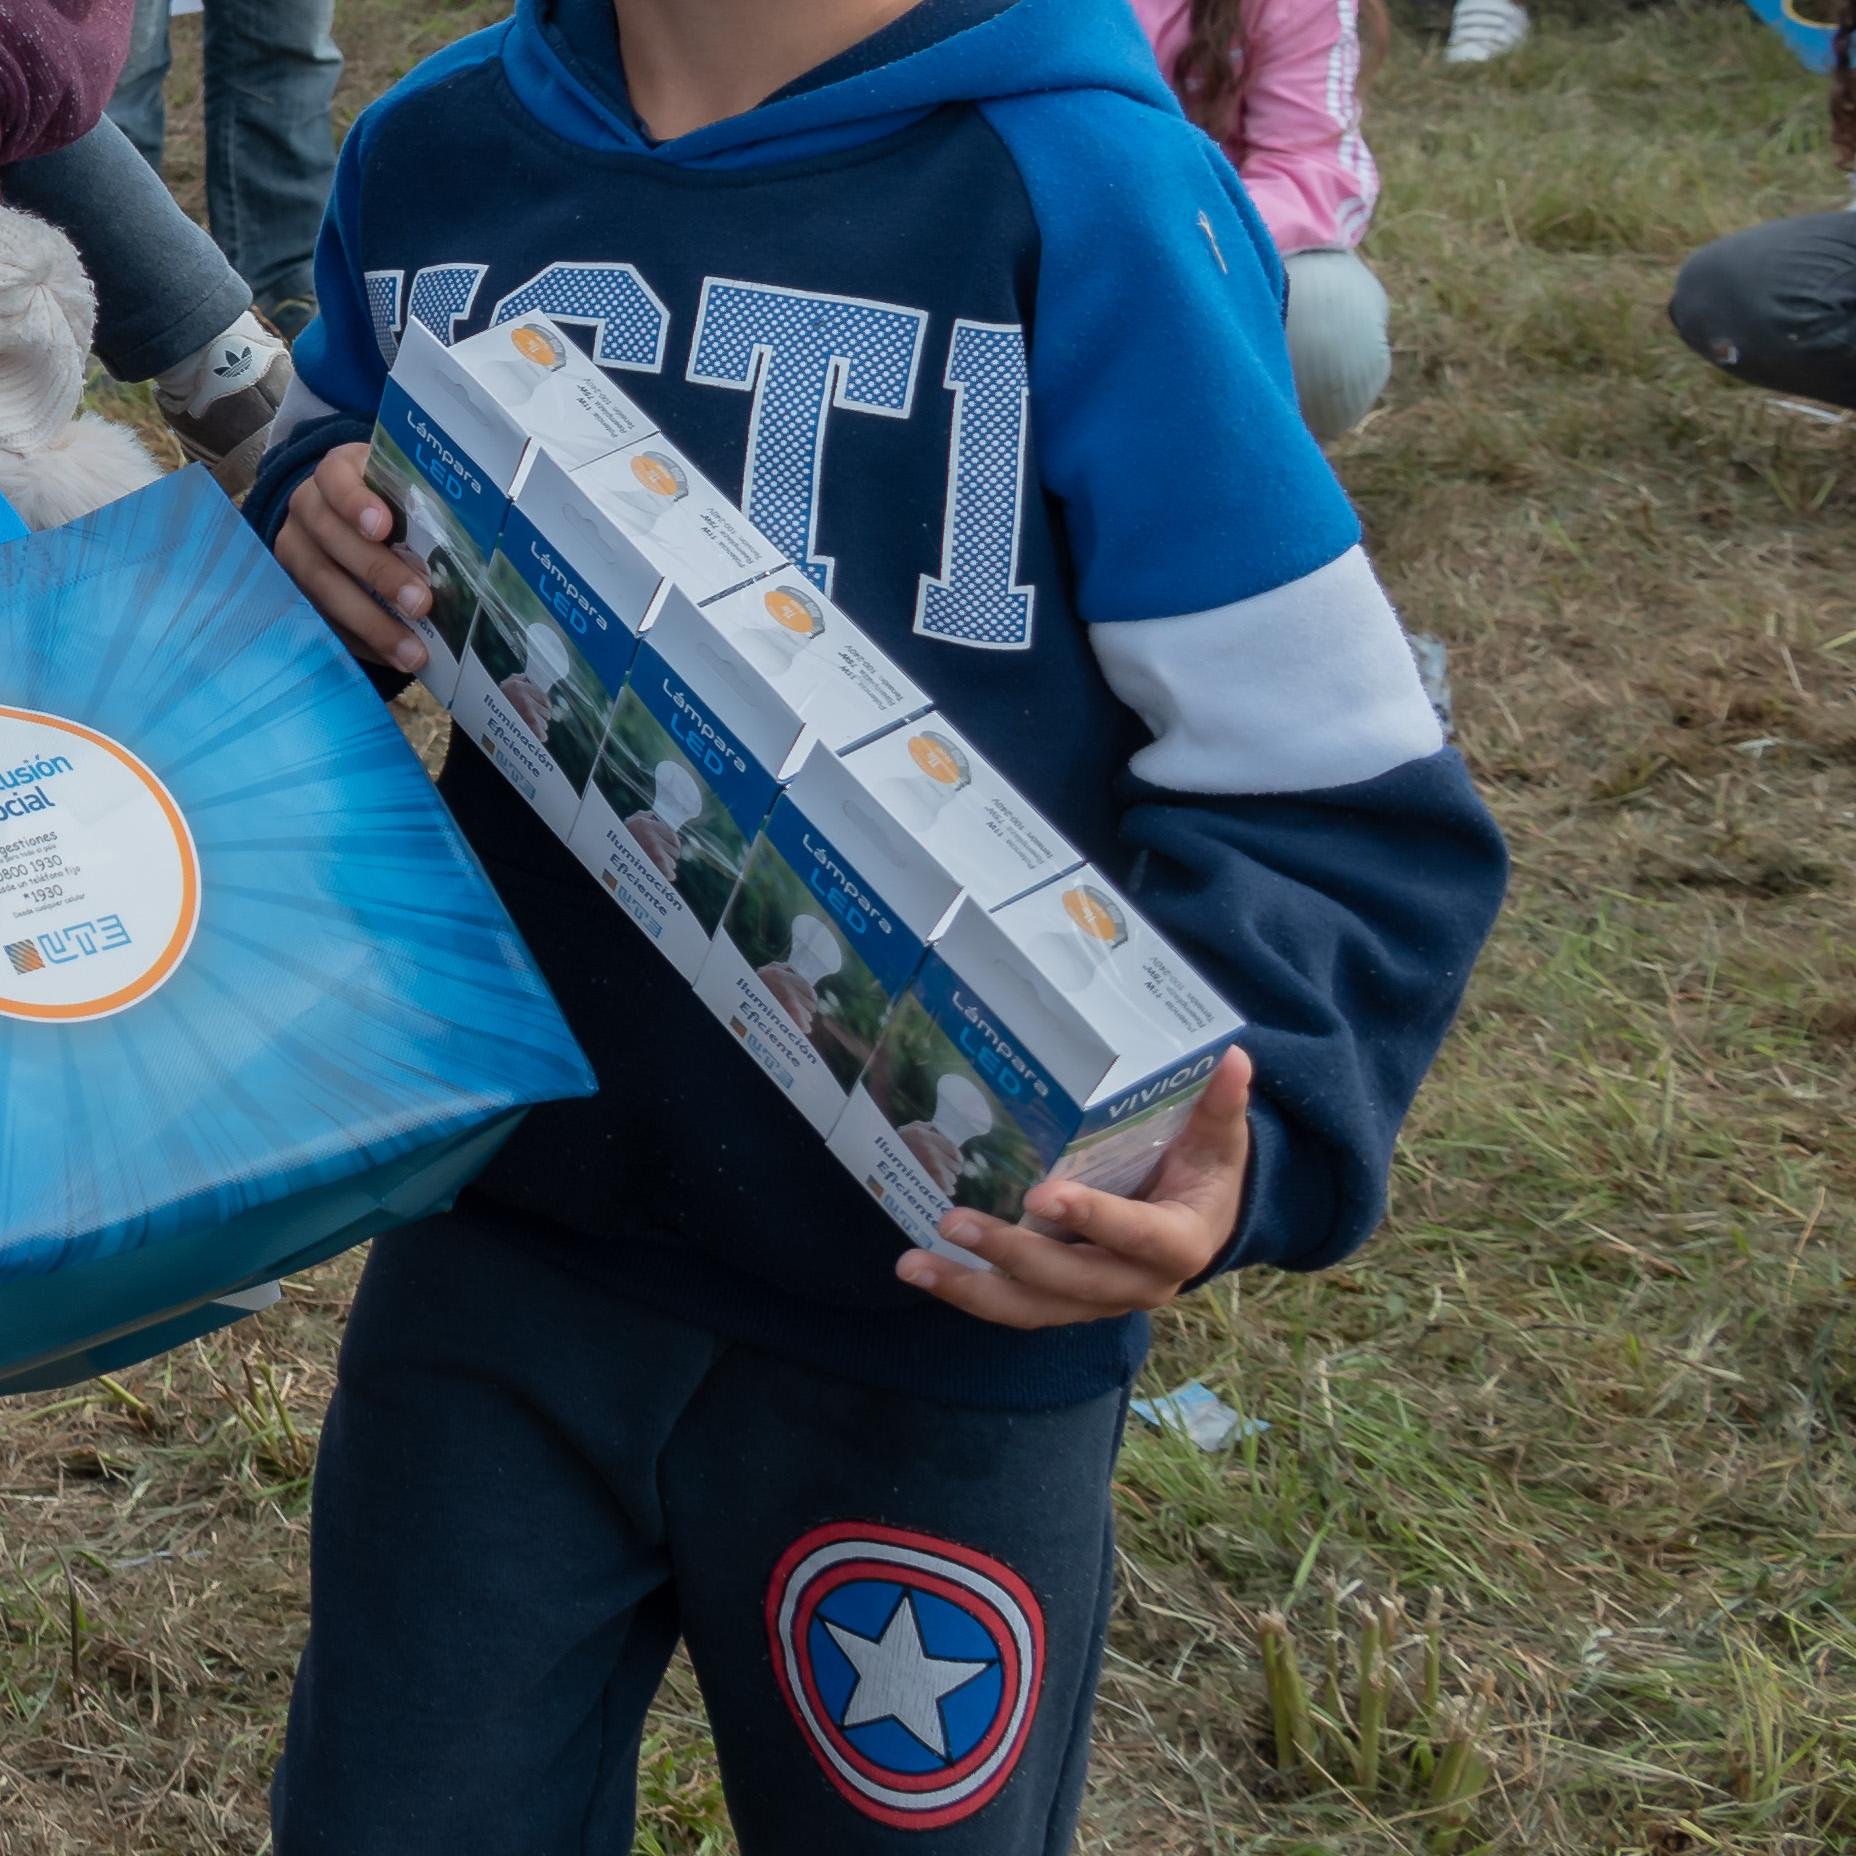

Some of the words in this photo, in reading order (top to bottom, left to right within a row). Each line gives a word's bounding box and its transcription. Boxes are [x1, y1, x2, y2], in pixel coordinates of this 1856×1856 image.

[407, 410, 482, 495] Lámpara
[415, 443, 463, 500] LED
[530, 541, 608, 631] Lámpara
[539, 574, 587, 634] LED
[483, 694, 554, 773] Iluminación
[488, 718, 541, 778] Eficiente
[662, 678, 746, 773] Lámpara
[670, 713, 724, 775] LED
[29, 854, 63, 873] 1930
[606, 830, 683, 912] Iluminación
[610, 853, 668, 916] Eficiente
[803, 833, 893, 934] Lámpara
[810, 867, 867, 934] LED
[736, 978, 818, 1065] Iluminación
[739, 1001, 801, 1068] Eficiente
[952, 991, 1049, 1097] Lámpara
[959, 1026, 1021, 1095] LED
